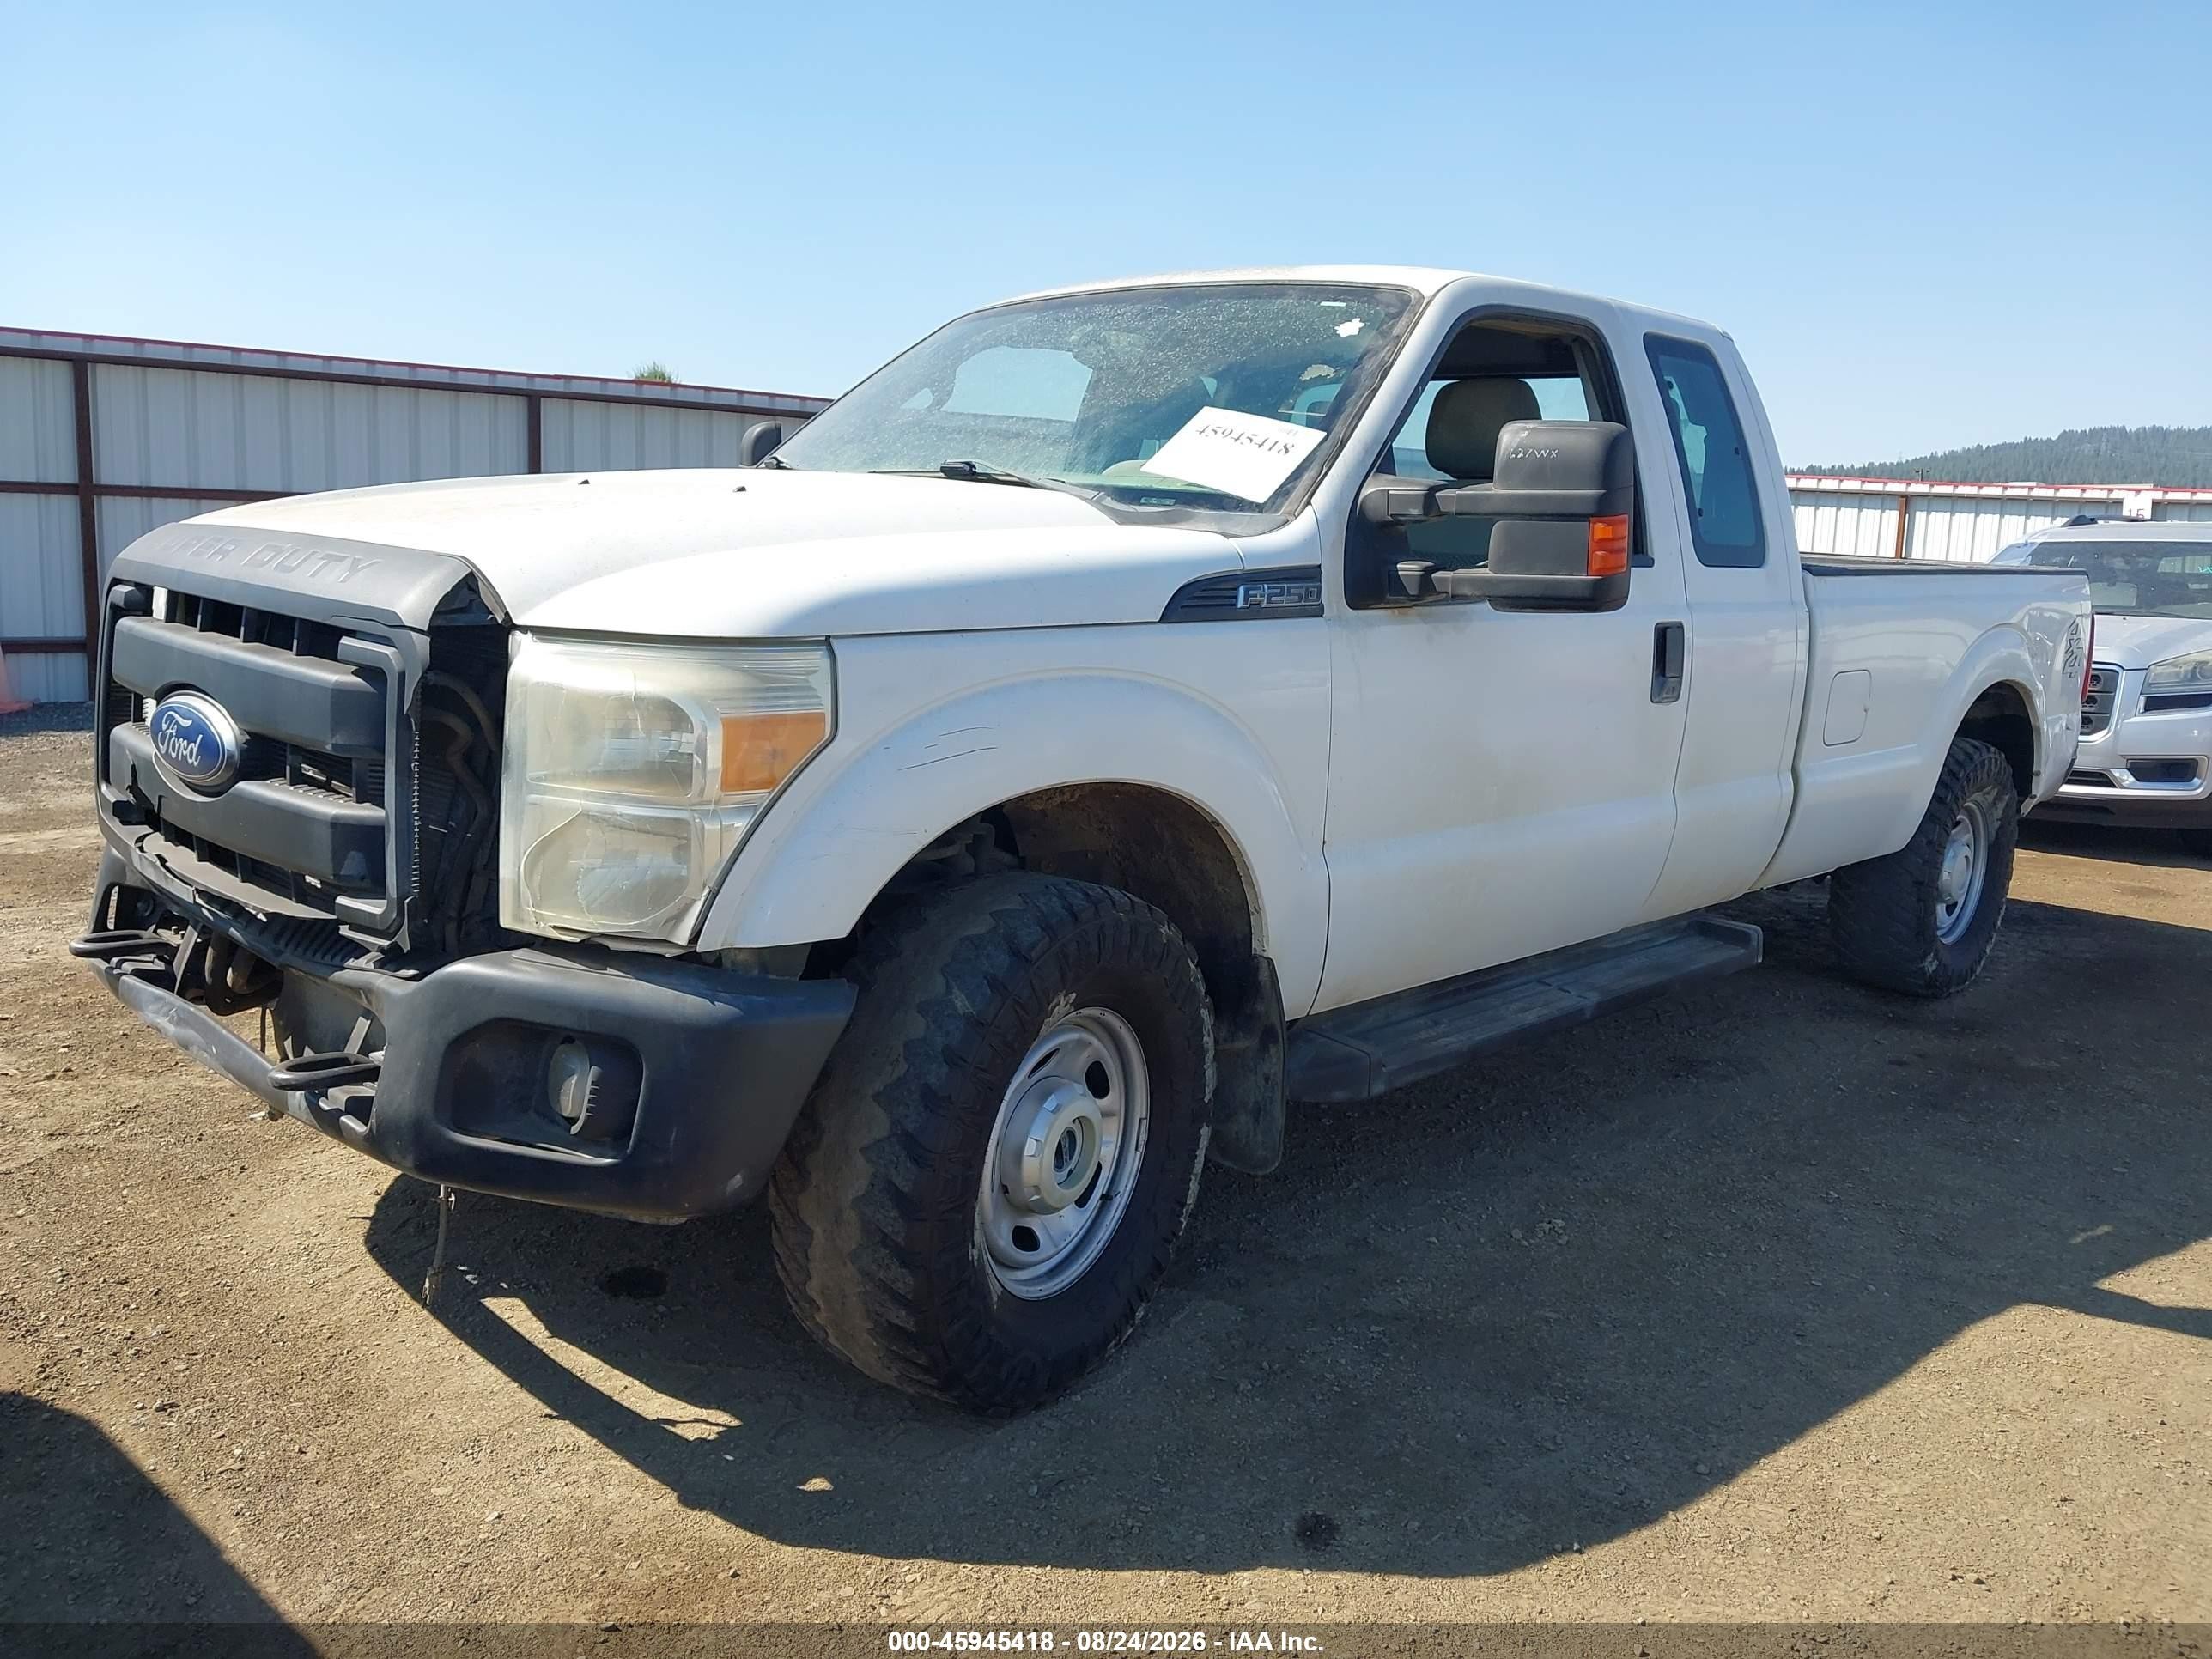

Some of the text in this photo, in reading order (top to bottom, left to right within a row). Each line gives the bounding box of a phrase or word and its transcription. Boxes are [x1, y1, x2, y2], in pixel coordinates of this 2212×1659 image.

[1195, 424, 1296, 455] 45945418
[240, 542, 384, 584] DUTY
[158, 711, 203, 767] Ford
